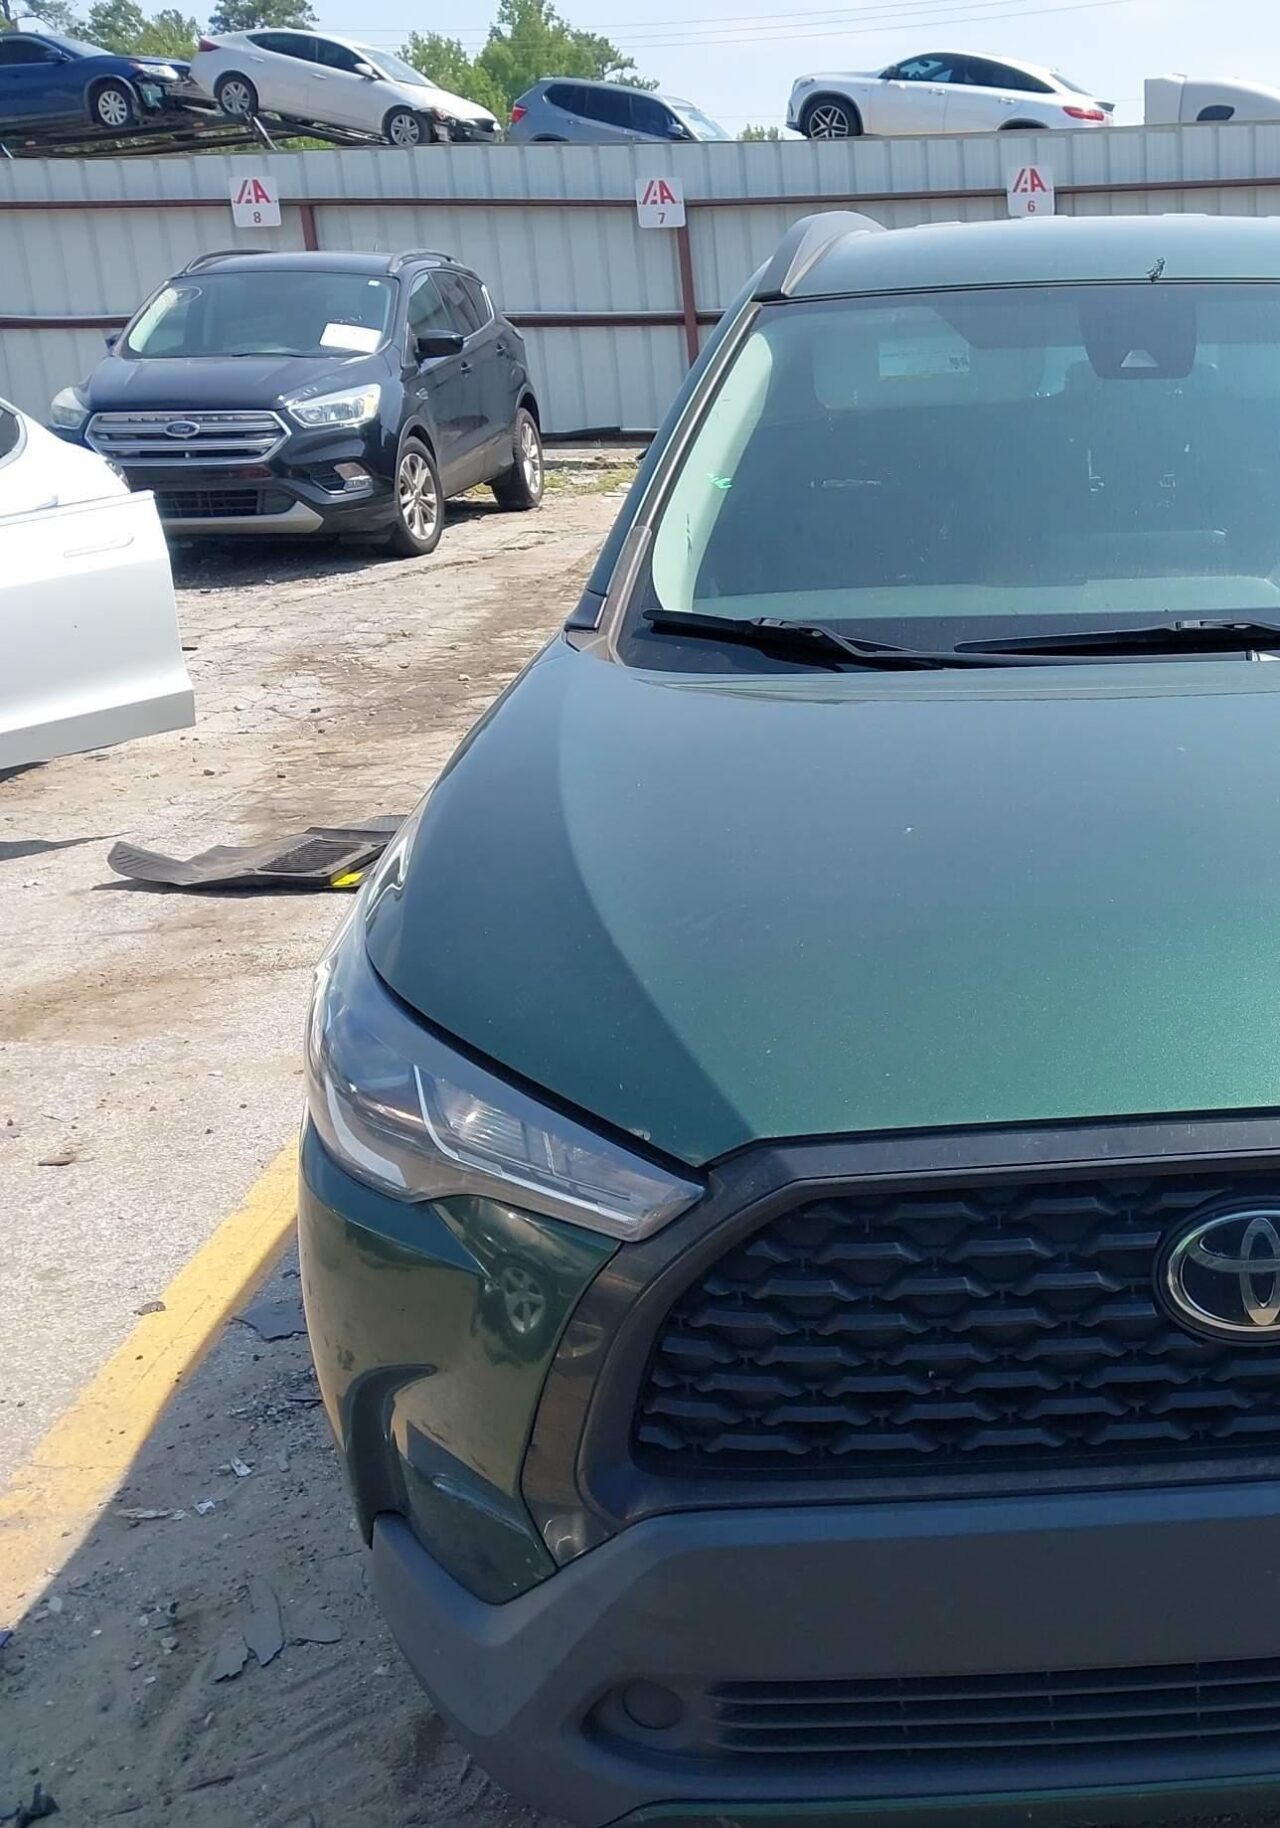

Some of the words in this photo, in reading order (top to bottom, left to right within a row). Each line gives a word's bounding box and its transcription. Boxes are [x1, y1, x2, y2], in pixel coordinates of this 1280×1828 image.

[1027, 200, 1036, 213] 6
[253, 211, 262, 224] 8
[657, 212, 666, 225] 7
